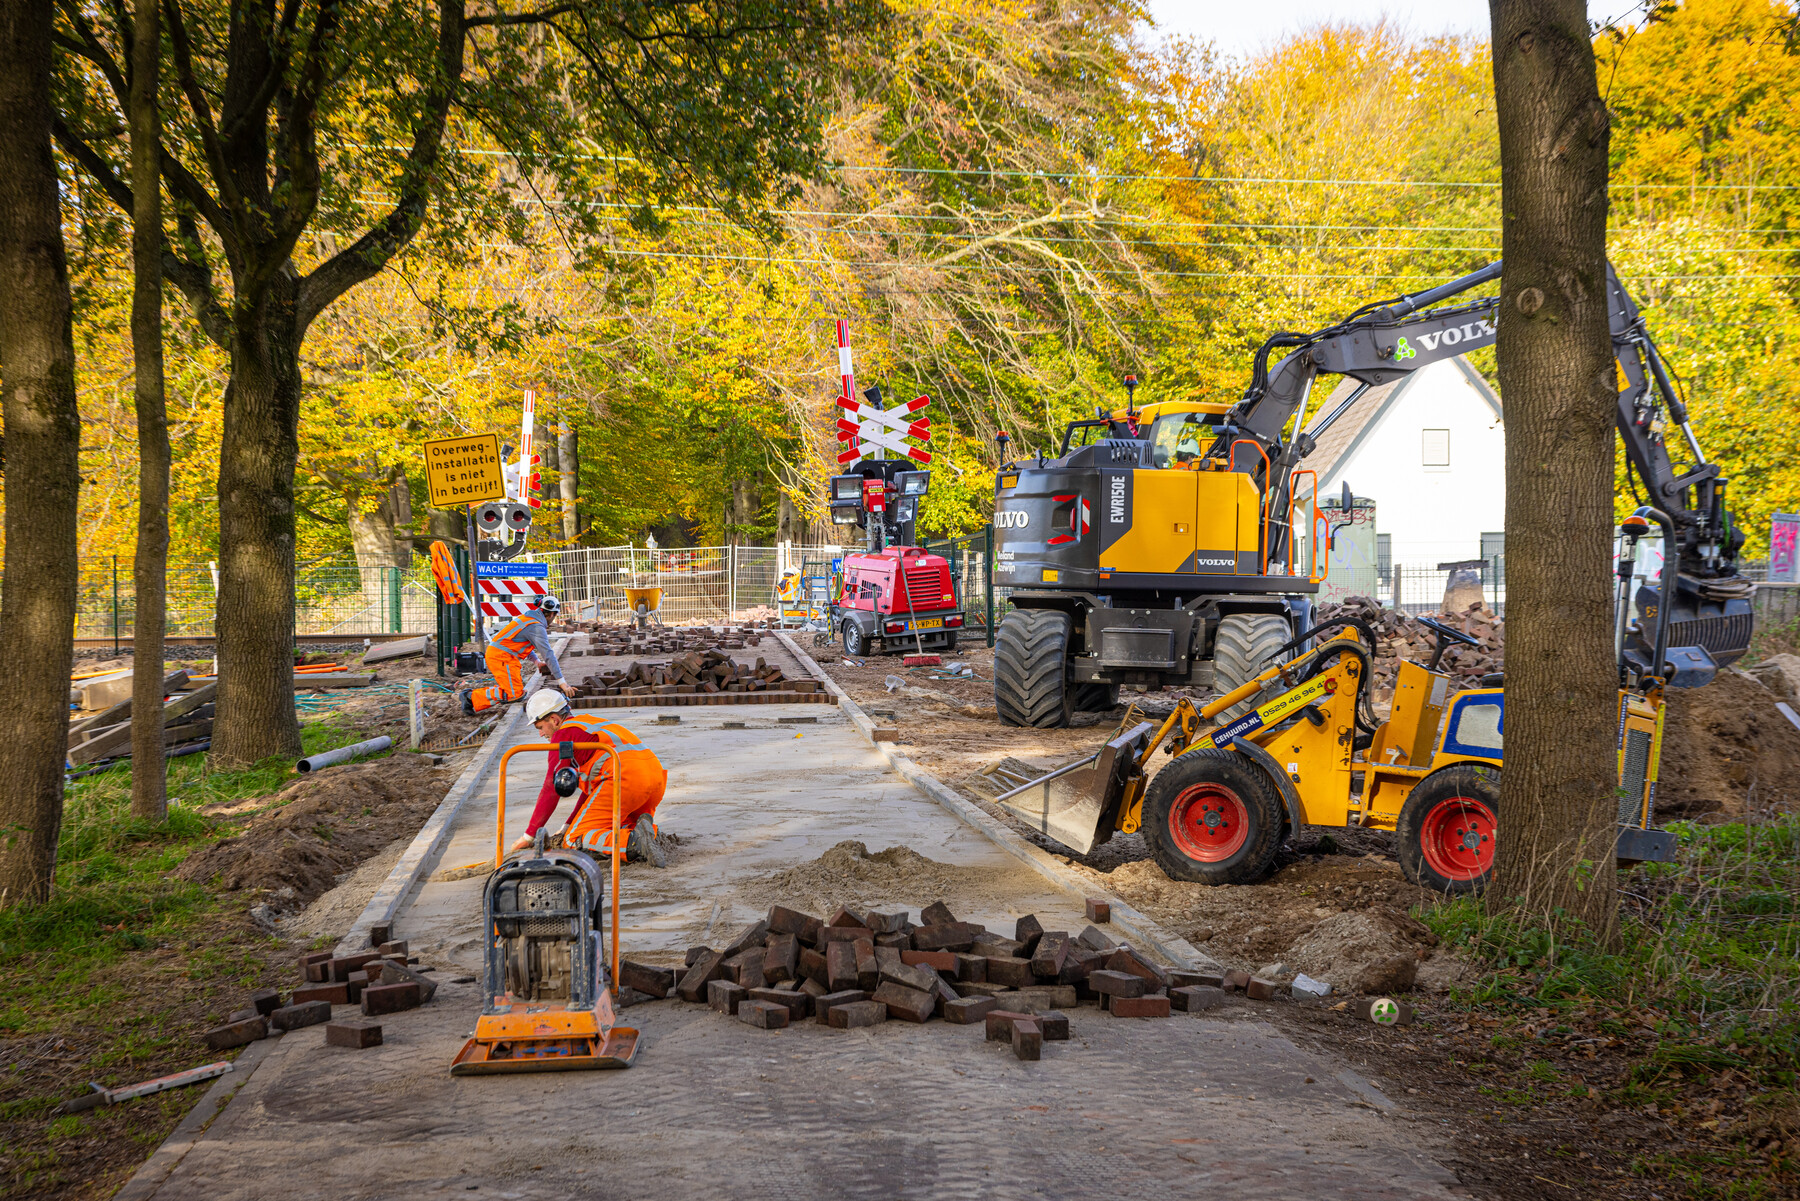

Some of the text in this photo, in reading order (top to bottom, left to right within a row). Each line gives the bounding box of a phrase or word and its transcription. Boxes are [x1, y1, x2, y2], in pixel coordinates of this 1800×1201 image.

[1416, 316, 1499, 351] VOLV
[432, 443, 490, 456] Overweg-
[430, 454, 496, 471] installatie
[445, 469, 485, 482] is niet
[435, 480, 498, 497] in bedrijf!
[1110, 476, 1125, 523] EWR150E
[994, 510, 1029, 528] OLVO
[478, 565, 509, 574] WACHT
[1197, 558, 1235, 566] VOLVO
[1214, 716, 1260, 745] GEHUURD.NL
[1263, 701, 1288, 718] 0529
[1288, 694, 1302, 705] 46
[1301, 686, 1316, 697] 96
